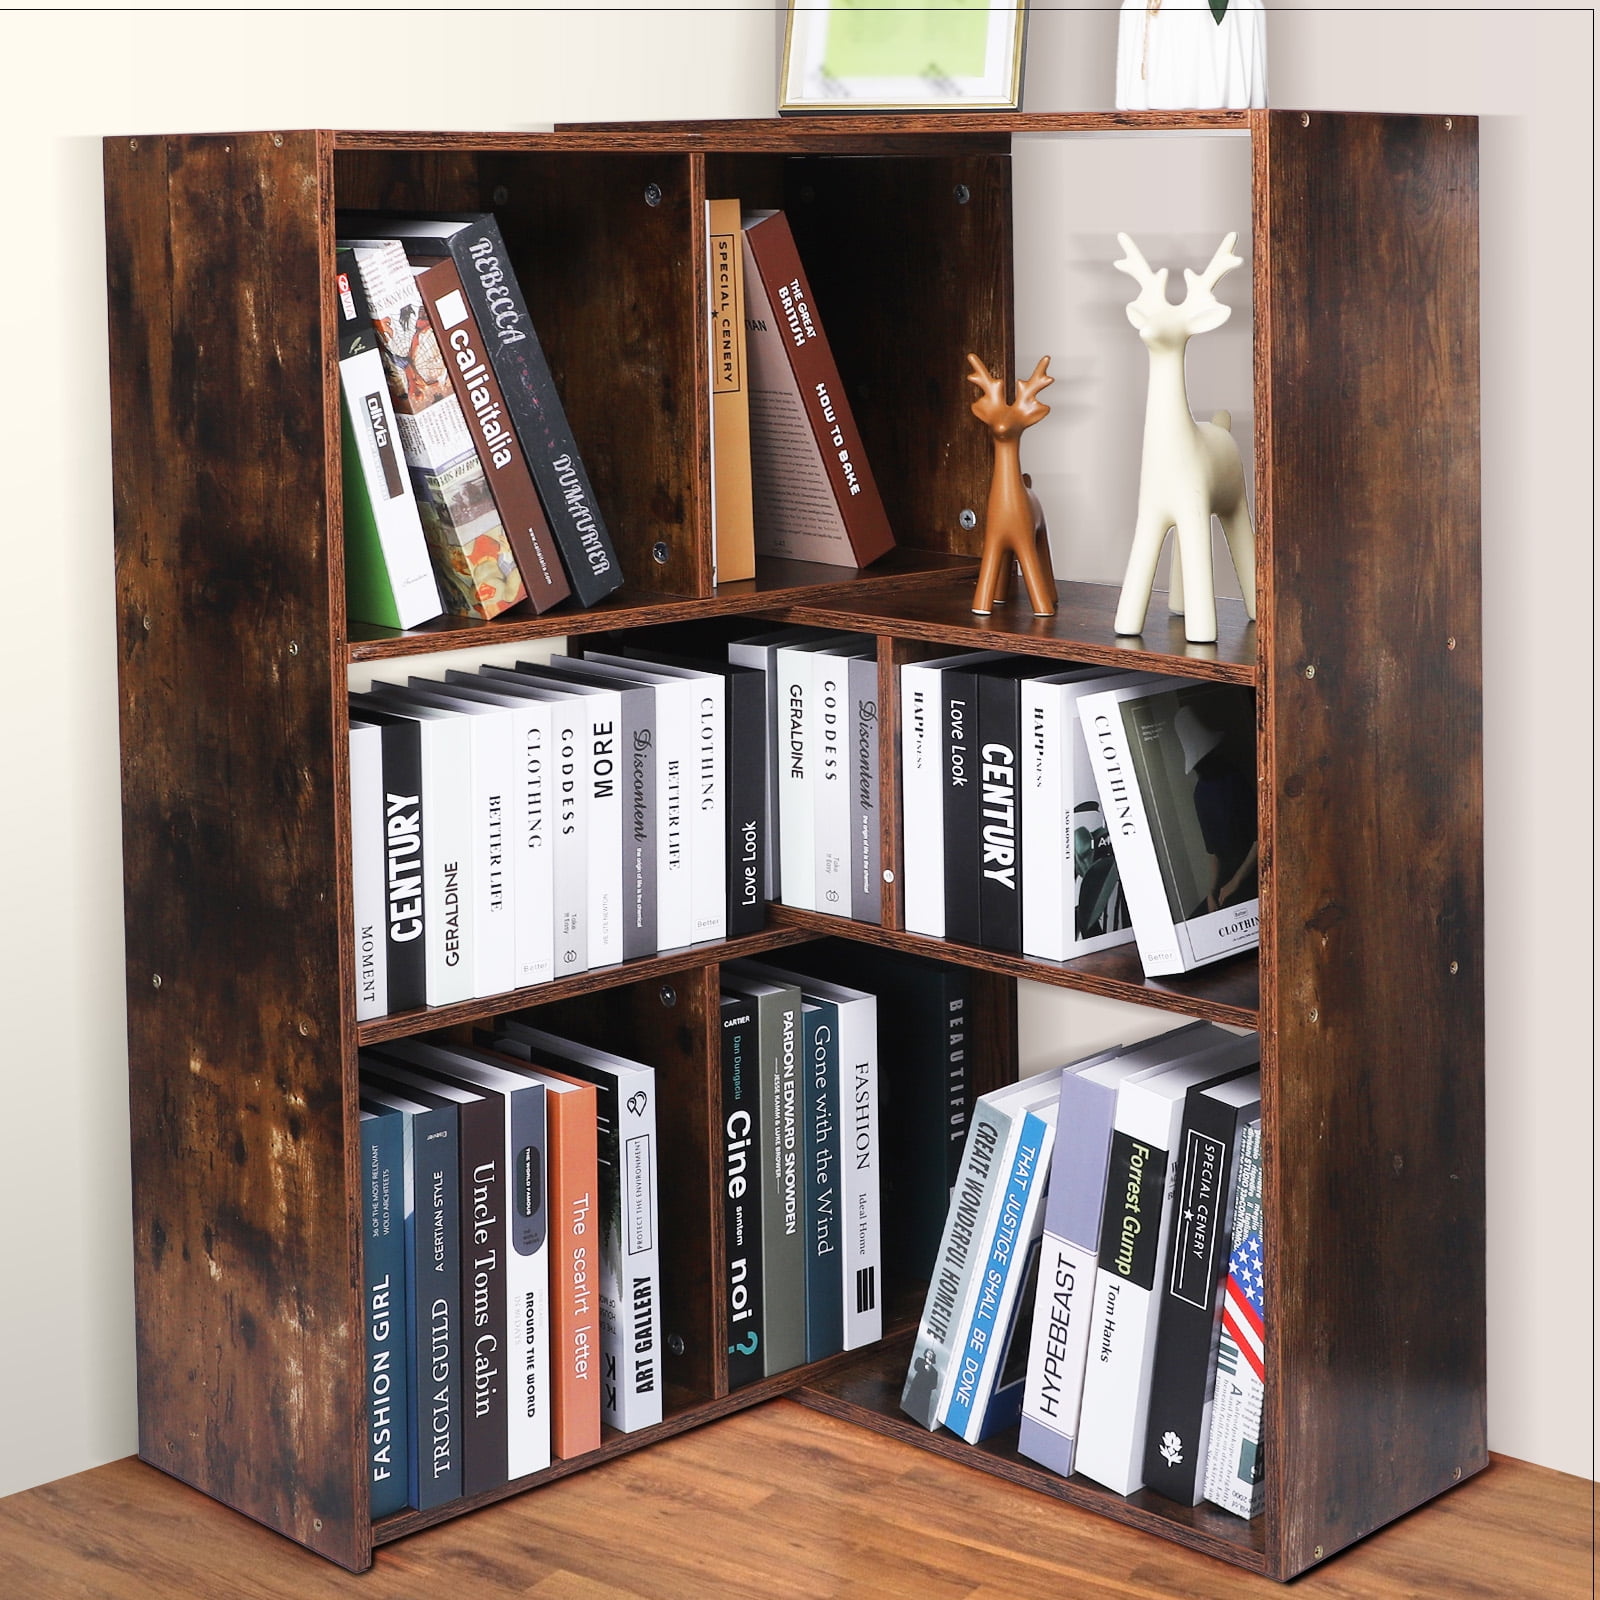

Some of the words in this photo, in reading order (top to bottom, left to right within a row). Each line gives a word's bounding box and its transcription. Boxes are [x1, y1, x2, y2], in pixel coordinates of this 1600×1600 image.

[469, 237, 527, 345] REBECCA
[718, 241, 730, 312] SPECIAL
[790, 278, 804, 302] THE
[797, 302, 816, 339] GREAT
[778, 286, 806, 347] BRITISH
[722, 318, 733, 384] CENERY
[367, 397, 388, 448] olivia
[450, 328, 512, 470] caliaitalia
[816, 382, 836, 424] HOW
[830, 424, 844, 447] TO
[838, 450, 861, 496] BAKE
[789, 684, 803, 780] GERALDINE
[823, 680, 838, 782] GODDESS
[950, 699, 966, 742] Love
[561, 728, 576, 836] GODDESS
[593, 720, 614, 800] MORE
[632, 728, 652, 843] Discontent
[700, 697, 714, 812] CLOTHING
[858, 700, 878, 811] Discontent
[951, 746, 967, 788] Look
[1094, 714, 1137, 838] CLOTHING
[526, 728, 544, 850] CLOTHING
[668, 760, 680, 827] BETTER
[981, 742, 1016, 890] CENTURY
[488, 795, 502, 865] BETTER
[669, 832, 680, 871] LIFE
[742, 820, 757, 861] Look
[386, 792, 423, 943] CENTURY
[490, 873, 503, 912] LIFE
[742, 866, 756, 906] Love
[444, 860, 459, 968] GERALDINE
[360, 926, 376, 1002] MOMENT
[724, 1016, 750, 1028] CARTIER
[733, 1035, 741, 1058] Dan
[782, 1010, 794, 1078] PARDON
[814, 1025, 831, 1090] Gone
[949, 999, 966, 1141] BEAUTIFUL
[783, 1082, 795, 1150] EDWARD
[815, 1093, 832, 1143] with
[855, 1062, 870, 1170] FASHION
[726, 1110, 752, 1200] Cine
[816, 1149, 832, 1185] the
[972, 1120, 999, 1180] CREATE
[1016, 1146, 1036, 1192] THAT
[1124, 1142, 1150, 1214] Forrest
[1201, 1142, 1217, 1200] SPECIAL
[1240, 1158, 1252, 1188] STUDIO
[434, 1170, 444, 1207] STYLE
[473, 1160, 496, 1245] Uncle
[572, 1192, 590, 1236] The
[784, 1152, 796, 1236] SNOWDEN
[858, 1193, 867, 1218] Ideal
[434, 1210, 444, 1261] CERTIAN
[816, 1188, 834, 1256] Wind
[859, 1220, 867, 1256] Home
[946, 1178, 986, 1270] WONDERFUL
[993, 1192, 1021, 1265] JUSTICE
[1114, 1215, 1141, 1276] Gump
[1192, 1204, 1210, 1261] CENERY
[434, 1262, 444, 1272] A
[474, 1249, 496, 1328] Toms
[728, 1258, 753, 1324] noi
[977, 1270, 1002, 1320] SHALL
[1104, 1283, 1120, 1315] Tom
[372, 1274, 391, 1341] GIRL
[526, 1292, 534, 1345] AROUND
[632, 1276, 652, 1355] GALLERY
[926, 1268, 962, 1344] HOMELIFE
[1039, 1252, 1078, 1418] HYPEBEAST
[431, 1298, 450, 1384] GUILD
[526, 1347, 534, 1371] THE
[574, 1326, 591, 1380] letter
[974, 1330, 986, 1353] BE
[1100, 1319, 1116, 1362] Hanks
[474, 1334, 498, 1419] Cabin
[526, 1373, 536, 1418] WORLD
[636, 1357, 654, 1394] ART
[955, 1360, 979, 1408] DONE
[1230, 1384, 1243, 1396] A
[373, 1344, 392, 1481] FASHION
[432, 1386, 452, 1479] TRICIA
